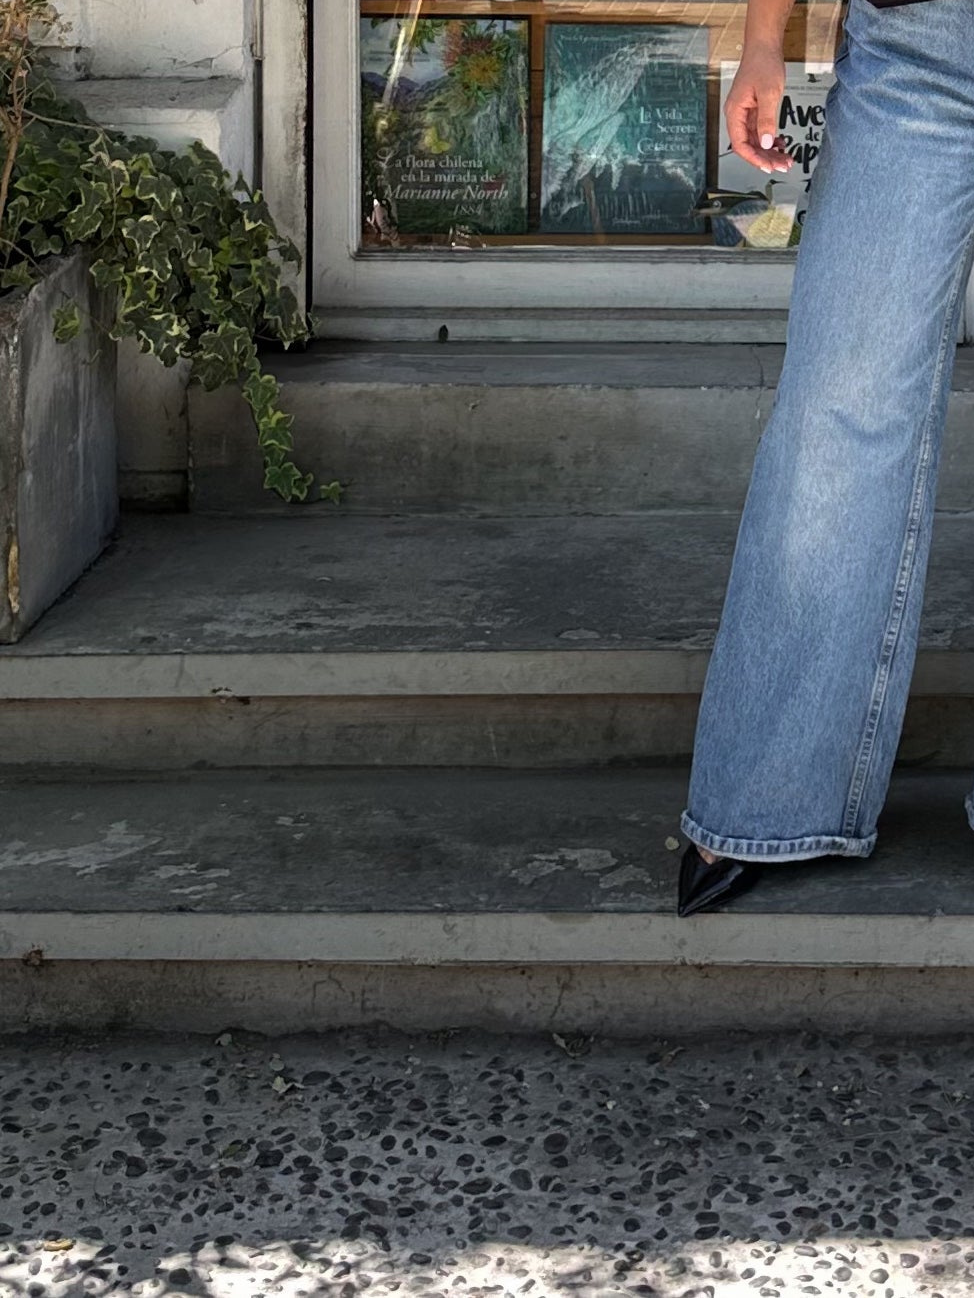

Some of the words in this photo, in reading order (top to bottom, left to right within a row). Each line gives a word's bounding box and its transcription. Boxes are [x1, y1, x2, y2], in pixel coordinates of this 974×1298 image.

[656, 107, 683, 120] Vida
[405, 154, 435, 169] flora
[438, 154, 483, 169] chilena
[401, 172, 416, 183] en
[419, 169, 431, 183] la
[434, 169, 478, 183] mirada
[480, 169, 497, 183] de
[383, 183, 460, 201] Marianne
[462, 183, 509, 201] North
